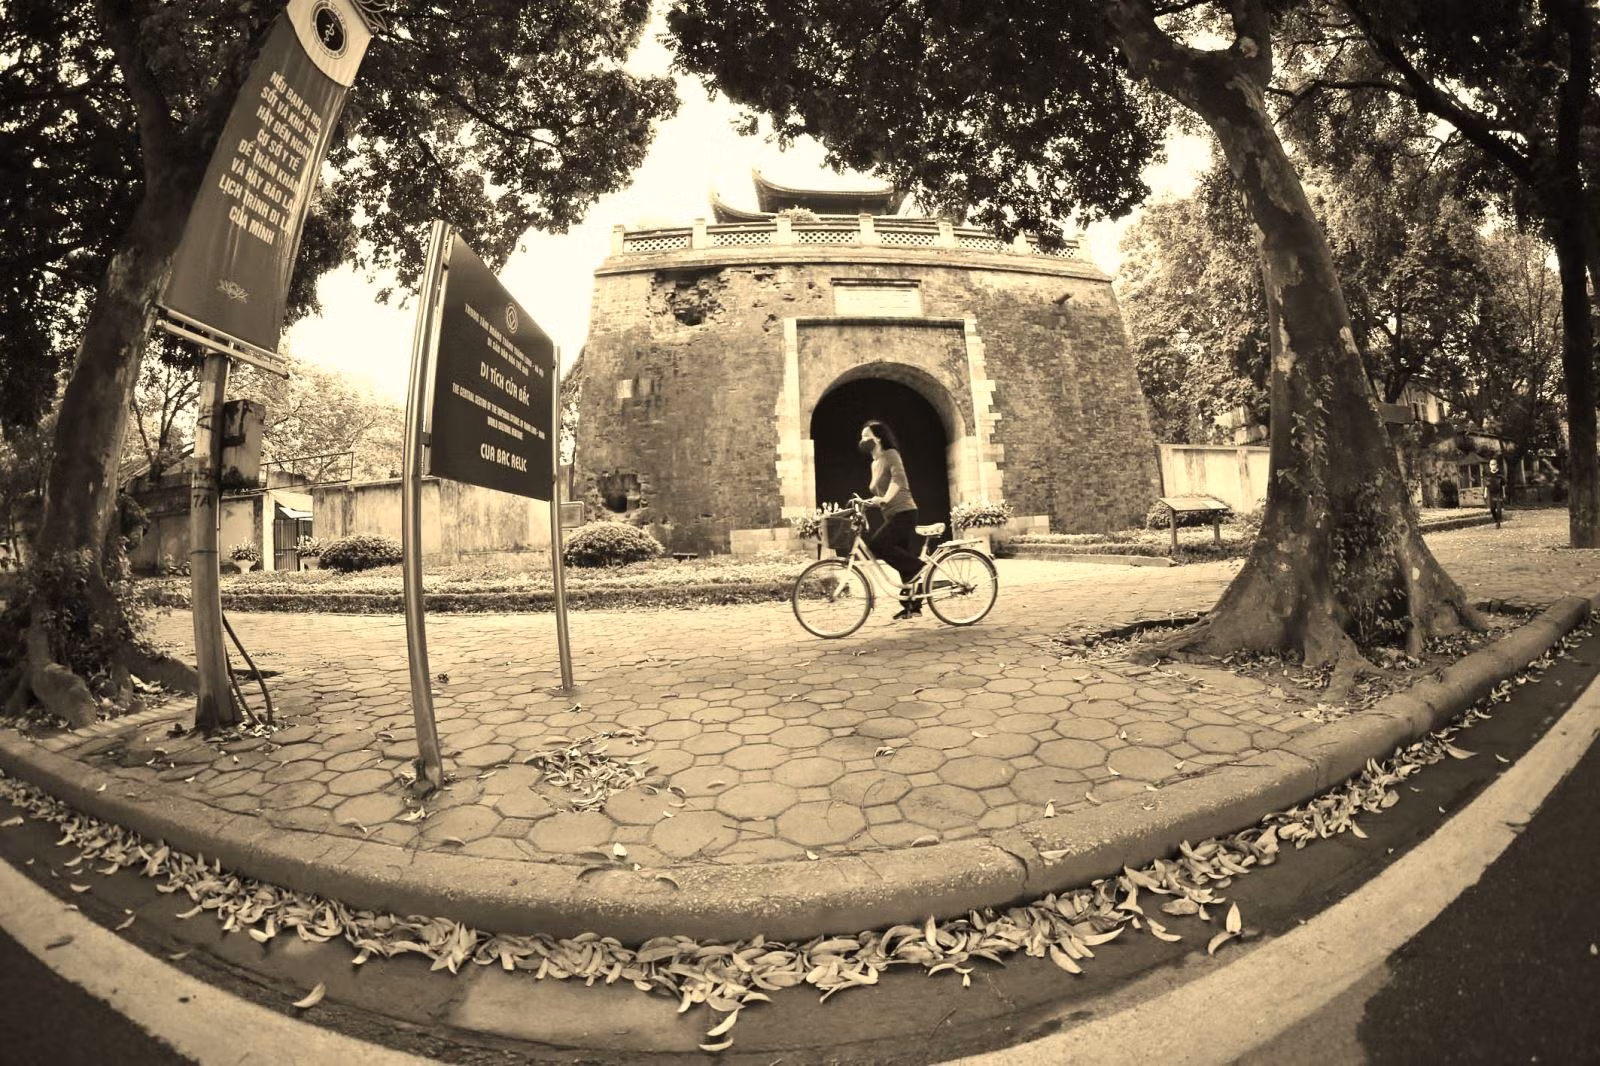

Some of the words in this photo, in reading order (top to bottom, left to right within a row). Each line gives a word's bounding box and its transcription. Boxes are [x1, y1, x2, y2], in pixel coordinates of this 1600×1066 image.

[261, 86, 278, 107] SỐT
[277, 101, 289, 119] VÀ
[288, 111, 305, 133] KHÓ
[270, 71, 287, 93] NẾU
[286, 88, 303, 111] BẠN
[302, 104, 312, 121] BỊ
[256, 105, 274, 127] HÃY
[273, 121, 291, 143] ĐẾN
[290, 136, 313, 161] NGAY
[257, 129, 270, 146] CƠ
[268, 140, 283, 157] SỞ
[282, 149, 289, 163] Y
[288, 155, 301, 172] TẾ
[218, 173, 243, 199] LỊCH
[243, 189, 270, 218] TRÌNH
[269, 208, 281, 225] ĐI
[231, 157, 246, 176] VÀ
[245, 167, 264, 190] HÃY
[263, 181, 282, 203] BÁO
[229, 205, 248, 230] CỦA
[248, 219, 275, 245] MÌNH
[480, 361, 489, 380] DI
[490, 367, 504, 390] TÍCH
[505, 377, 518, 399] CỬA
[518, 385, 530, 407] BẮC
[480, 443, 495, 462] CUA
[496, 448, 510, 467] BAC
[511, 454, 527, 472] RELIC
